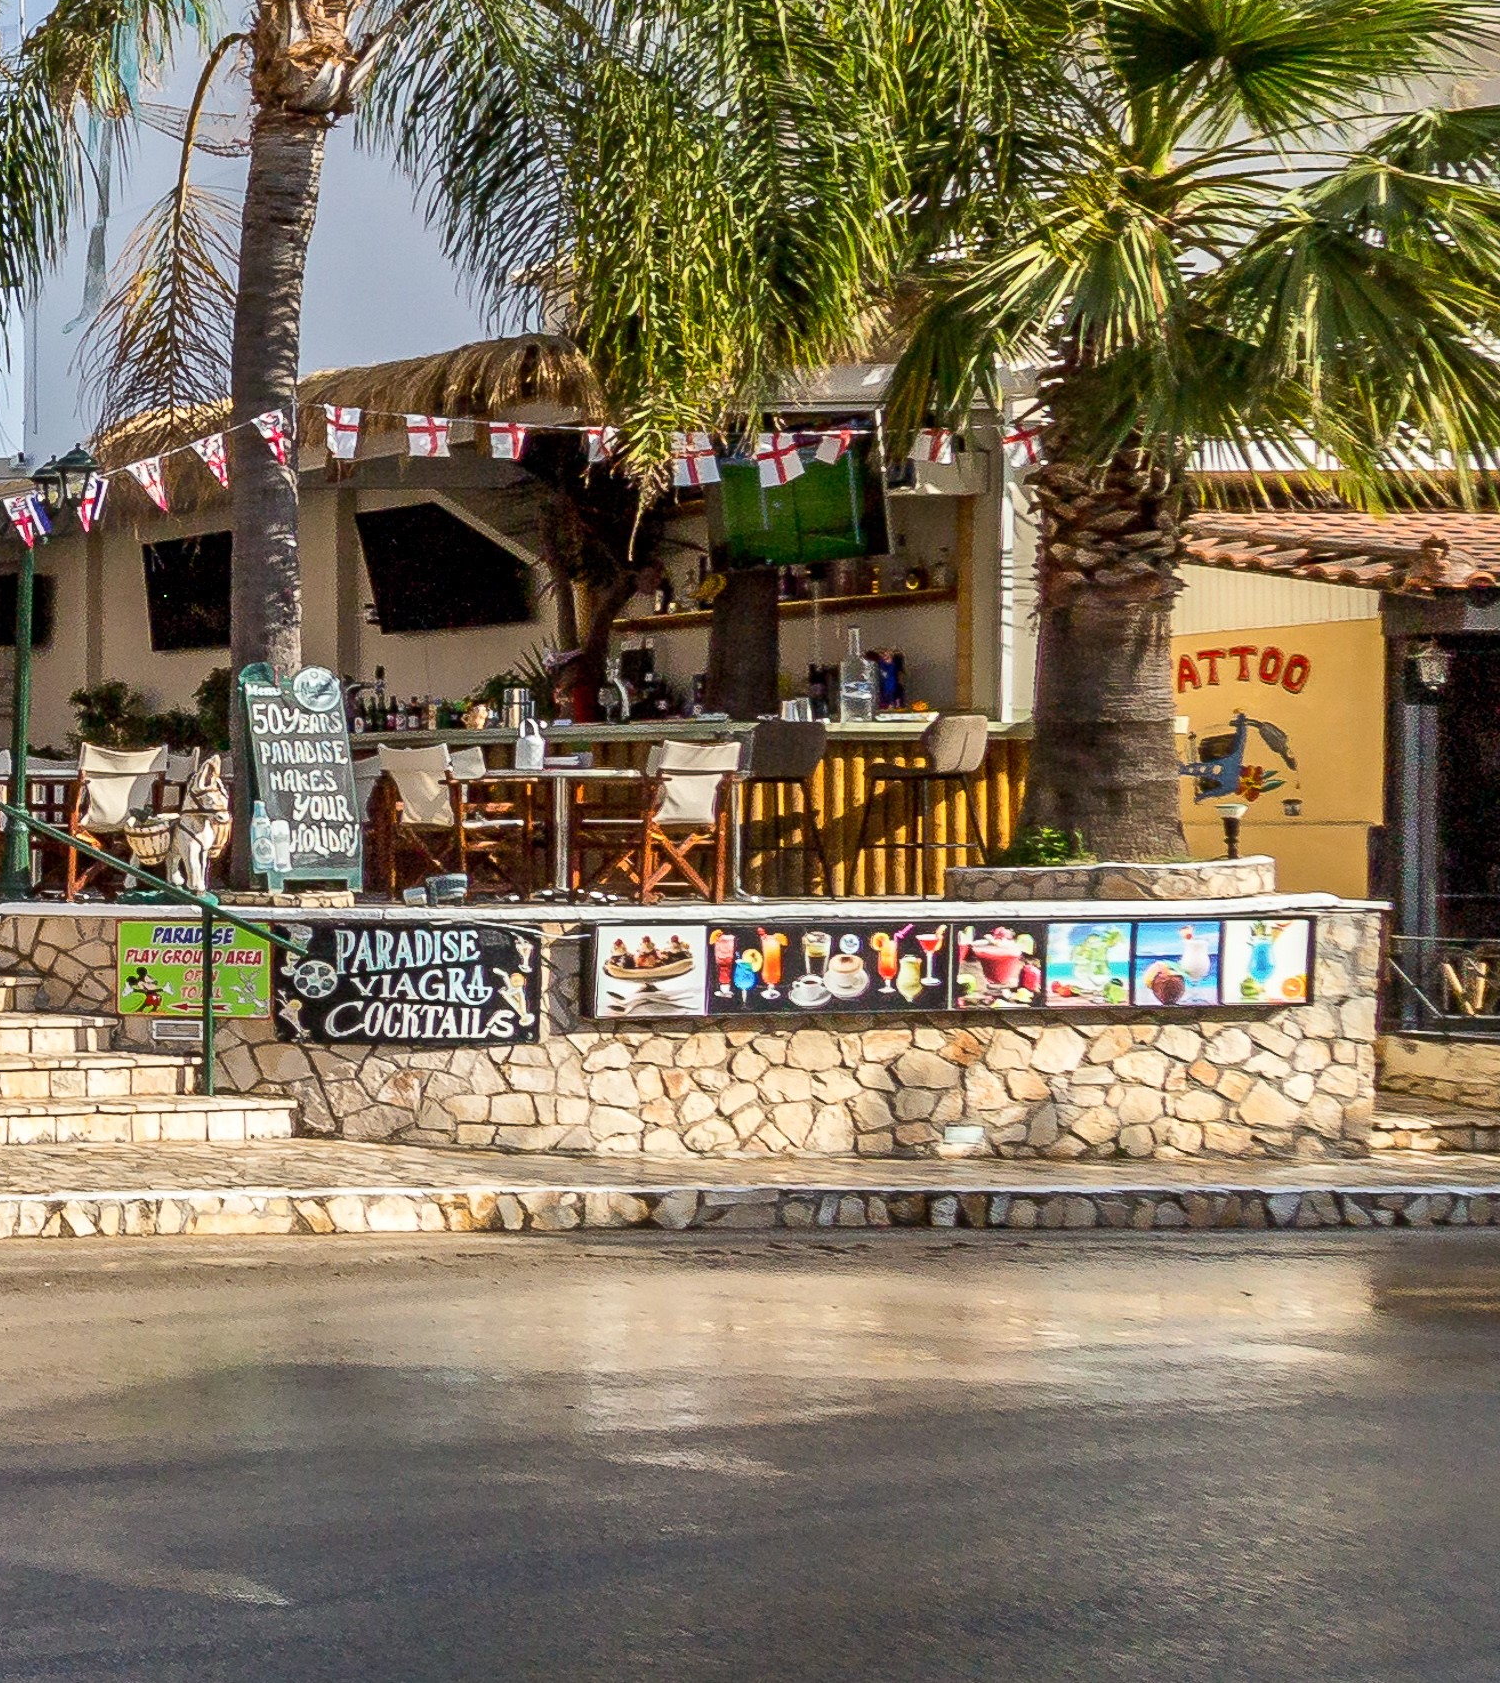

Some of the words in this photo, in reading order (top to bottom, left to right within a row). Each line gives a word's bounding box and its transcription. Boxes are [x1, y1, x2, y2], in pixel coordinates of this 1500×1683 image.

[1177, 645, 1311, 695] ATTOO
[258, 739, 349, 766] PARADISE
[269, 769, 338, 792] MAKES
[293, 793, 355, 822] YOUR
[151, 926, 235, 947] PARADSE
[124, 949, 158, 965] PLAY
[161, 949, 225, 966] GROUD
[226, 949, 263, 966] AREA
[336, 929, 481, 974] PARADISE
[350, 966, 494, 1002] VIAGRA
[324, 1000, 516, 1041] COCKTAILS
